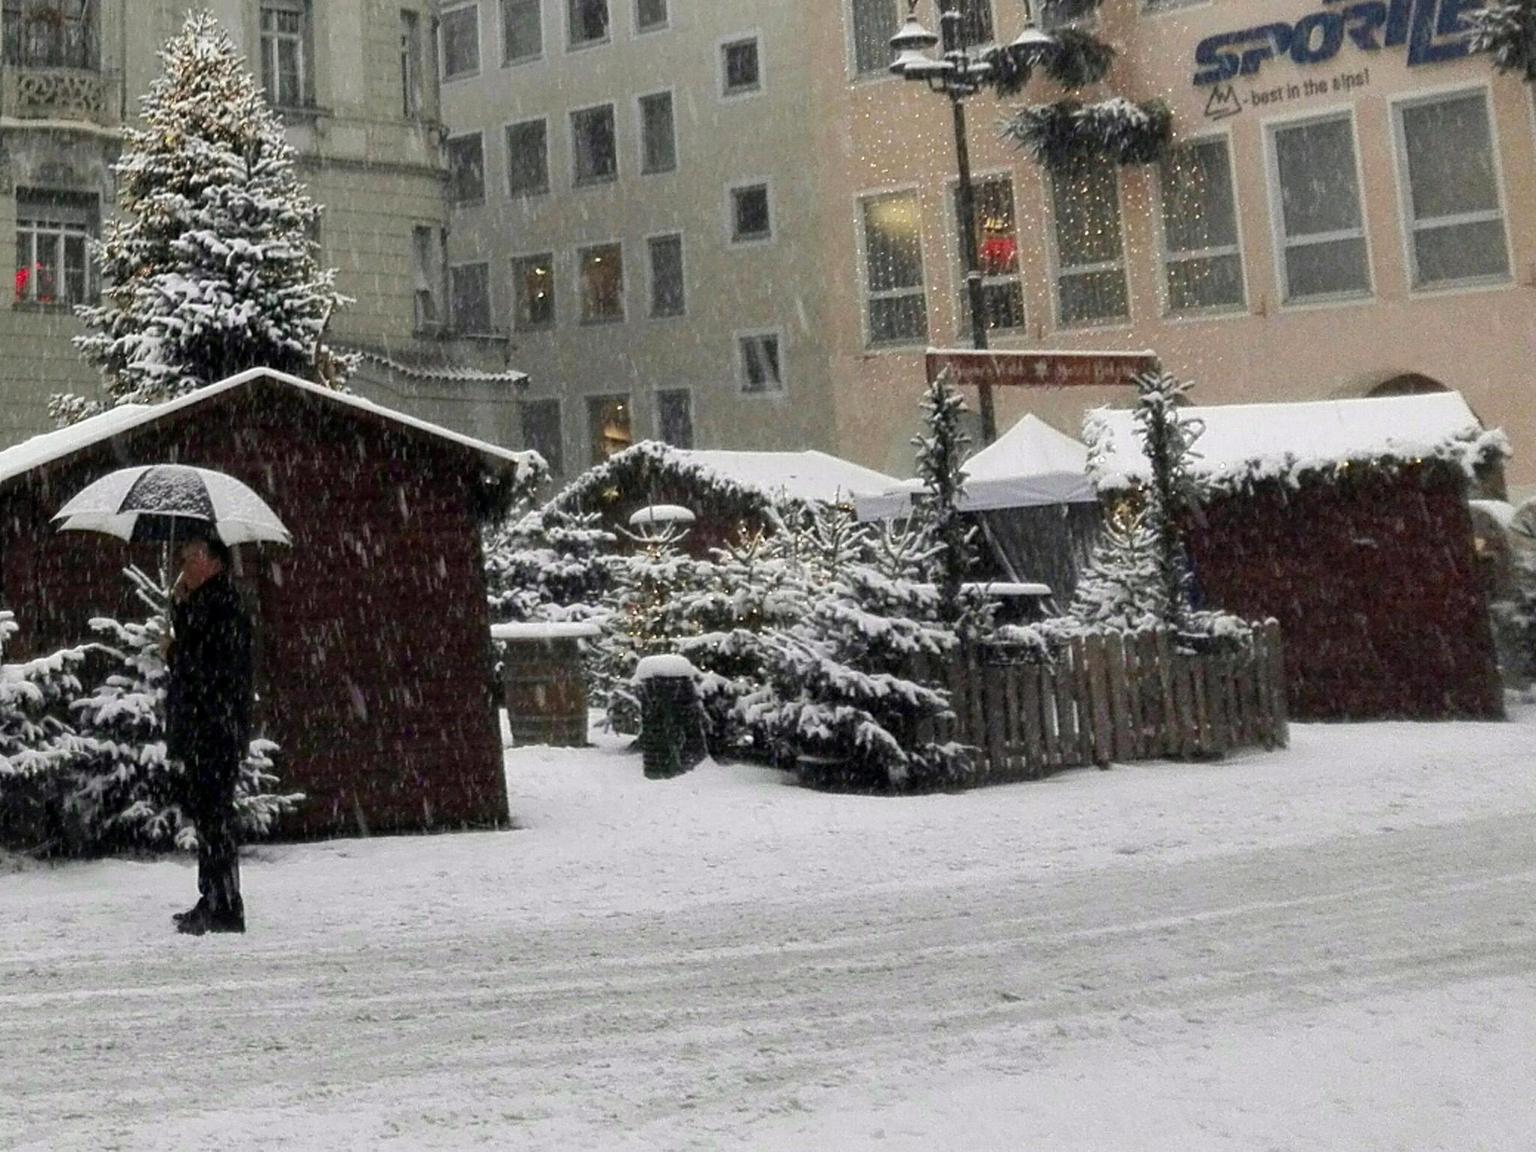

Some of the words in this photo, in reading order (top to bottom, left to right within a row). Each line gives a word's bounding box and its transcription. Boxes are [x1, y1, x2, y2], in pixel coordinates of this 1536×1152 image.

[1251, 89, 1283, 107] best
[1287, 82, 1300, 99] in
[1303, 77, 1328, 96] the
